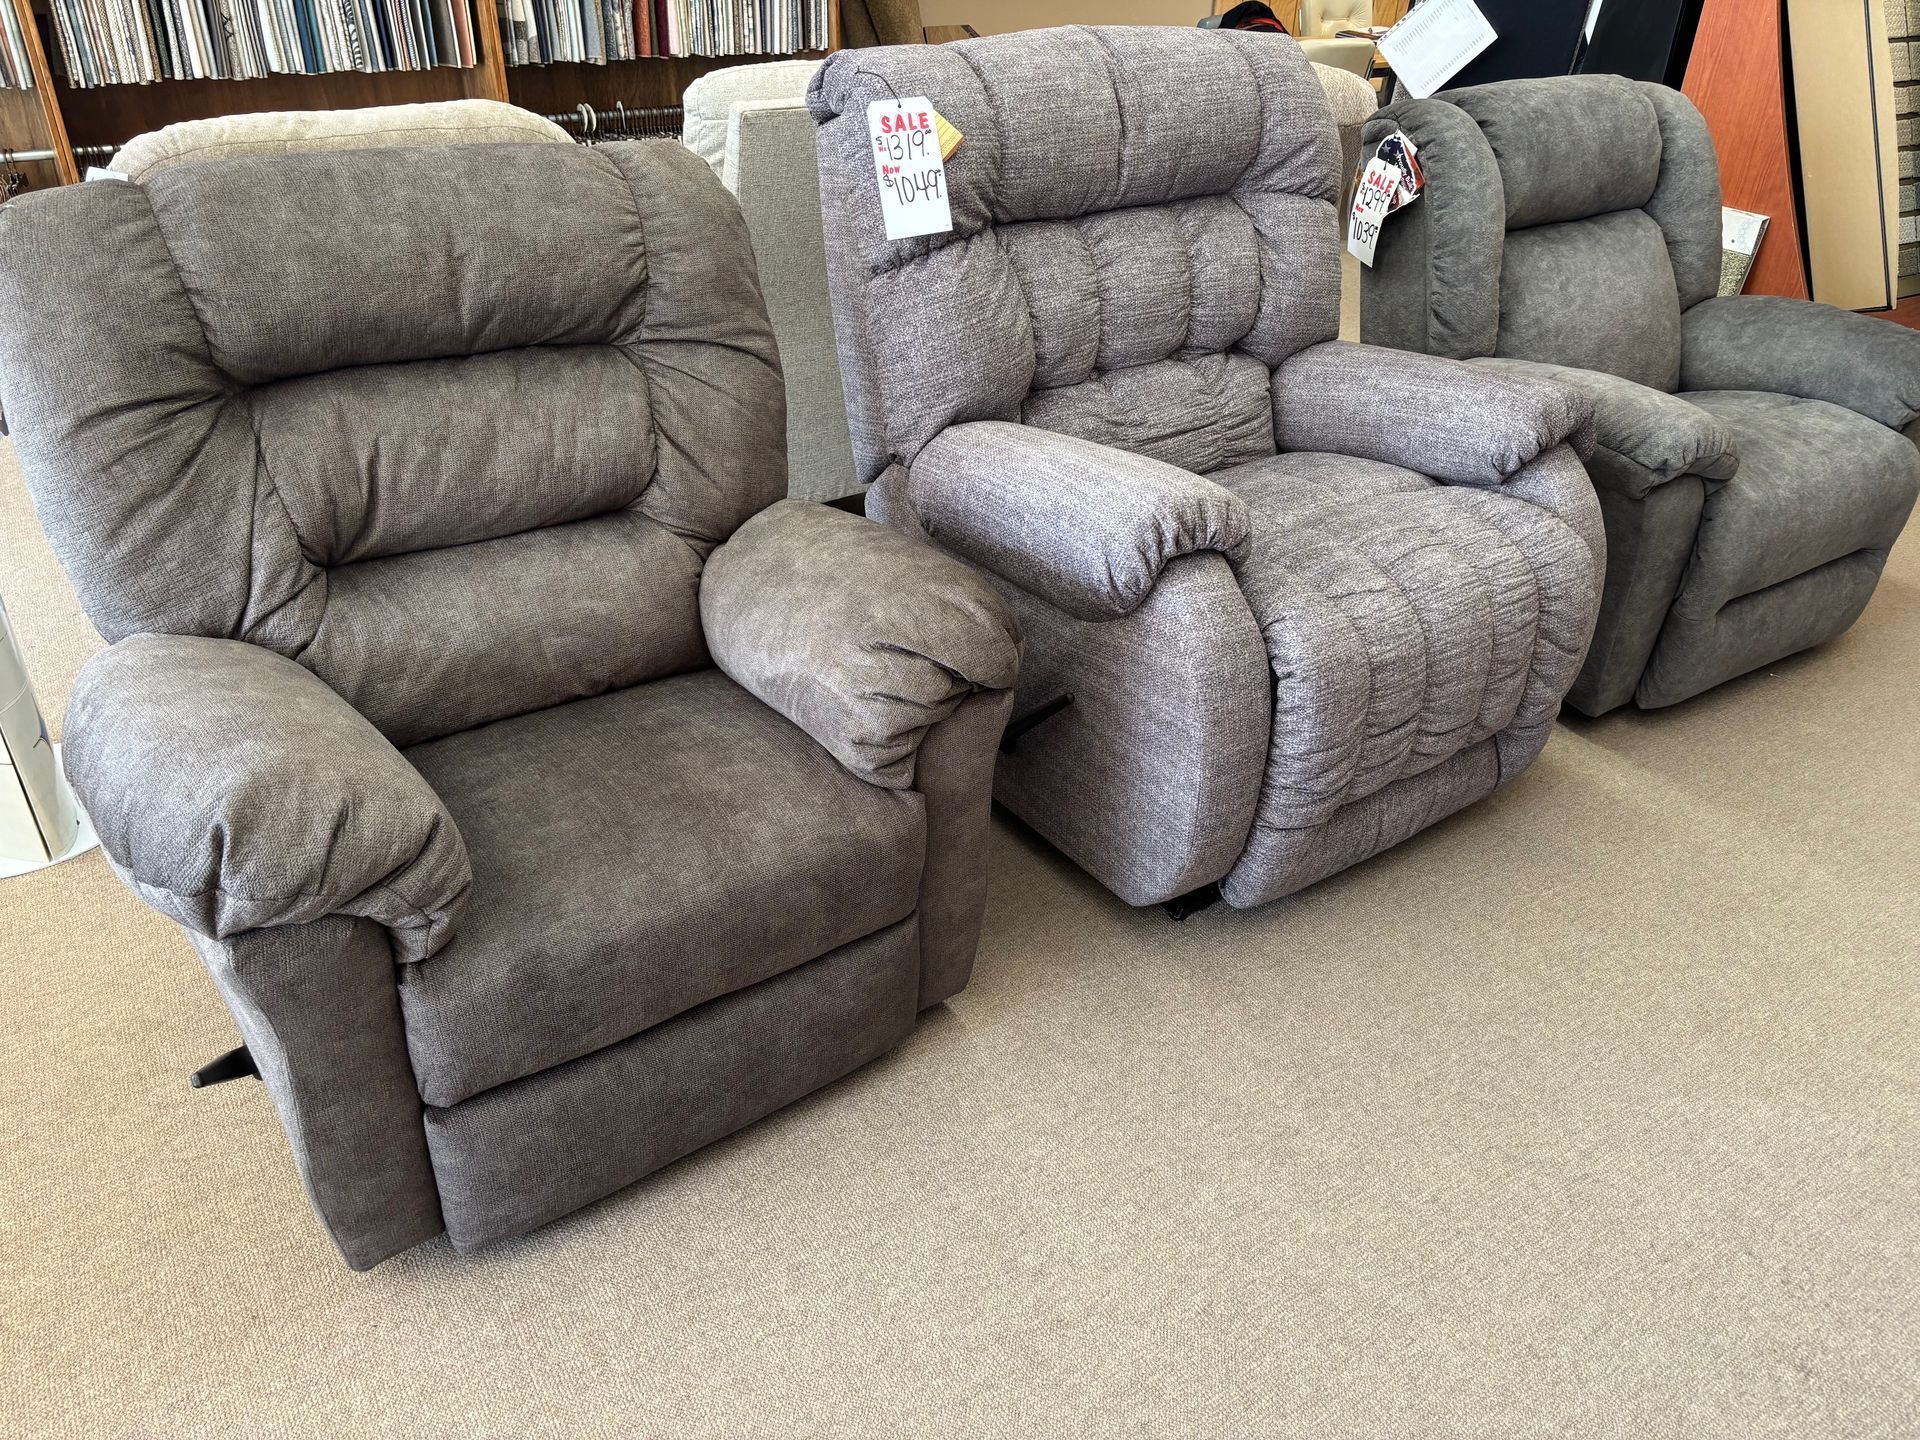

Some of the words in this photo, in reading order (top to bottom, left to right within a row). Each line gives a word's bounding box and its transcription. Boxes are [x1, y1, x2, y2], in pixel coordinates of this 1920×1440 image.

[881, 112, 929, 134] SALE
[882, 164, 900, 175] Now
[1367, 170, 1394, 193] SALE
